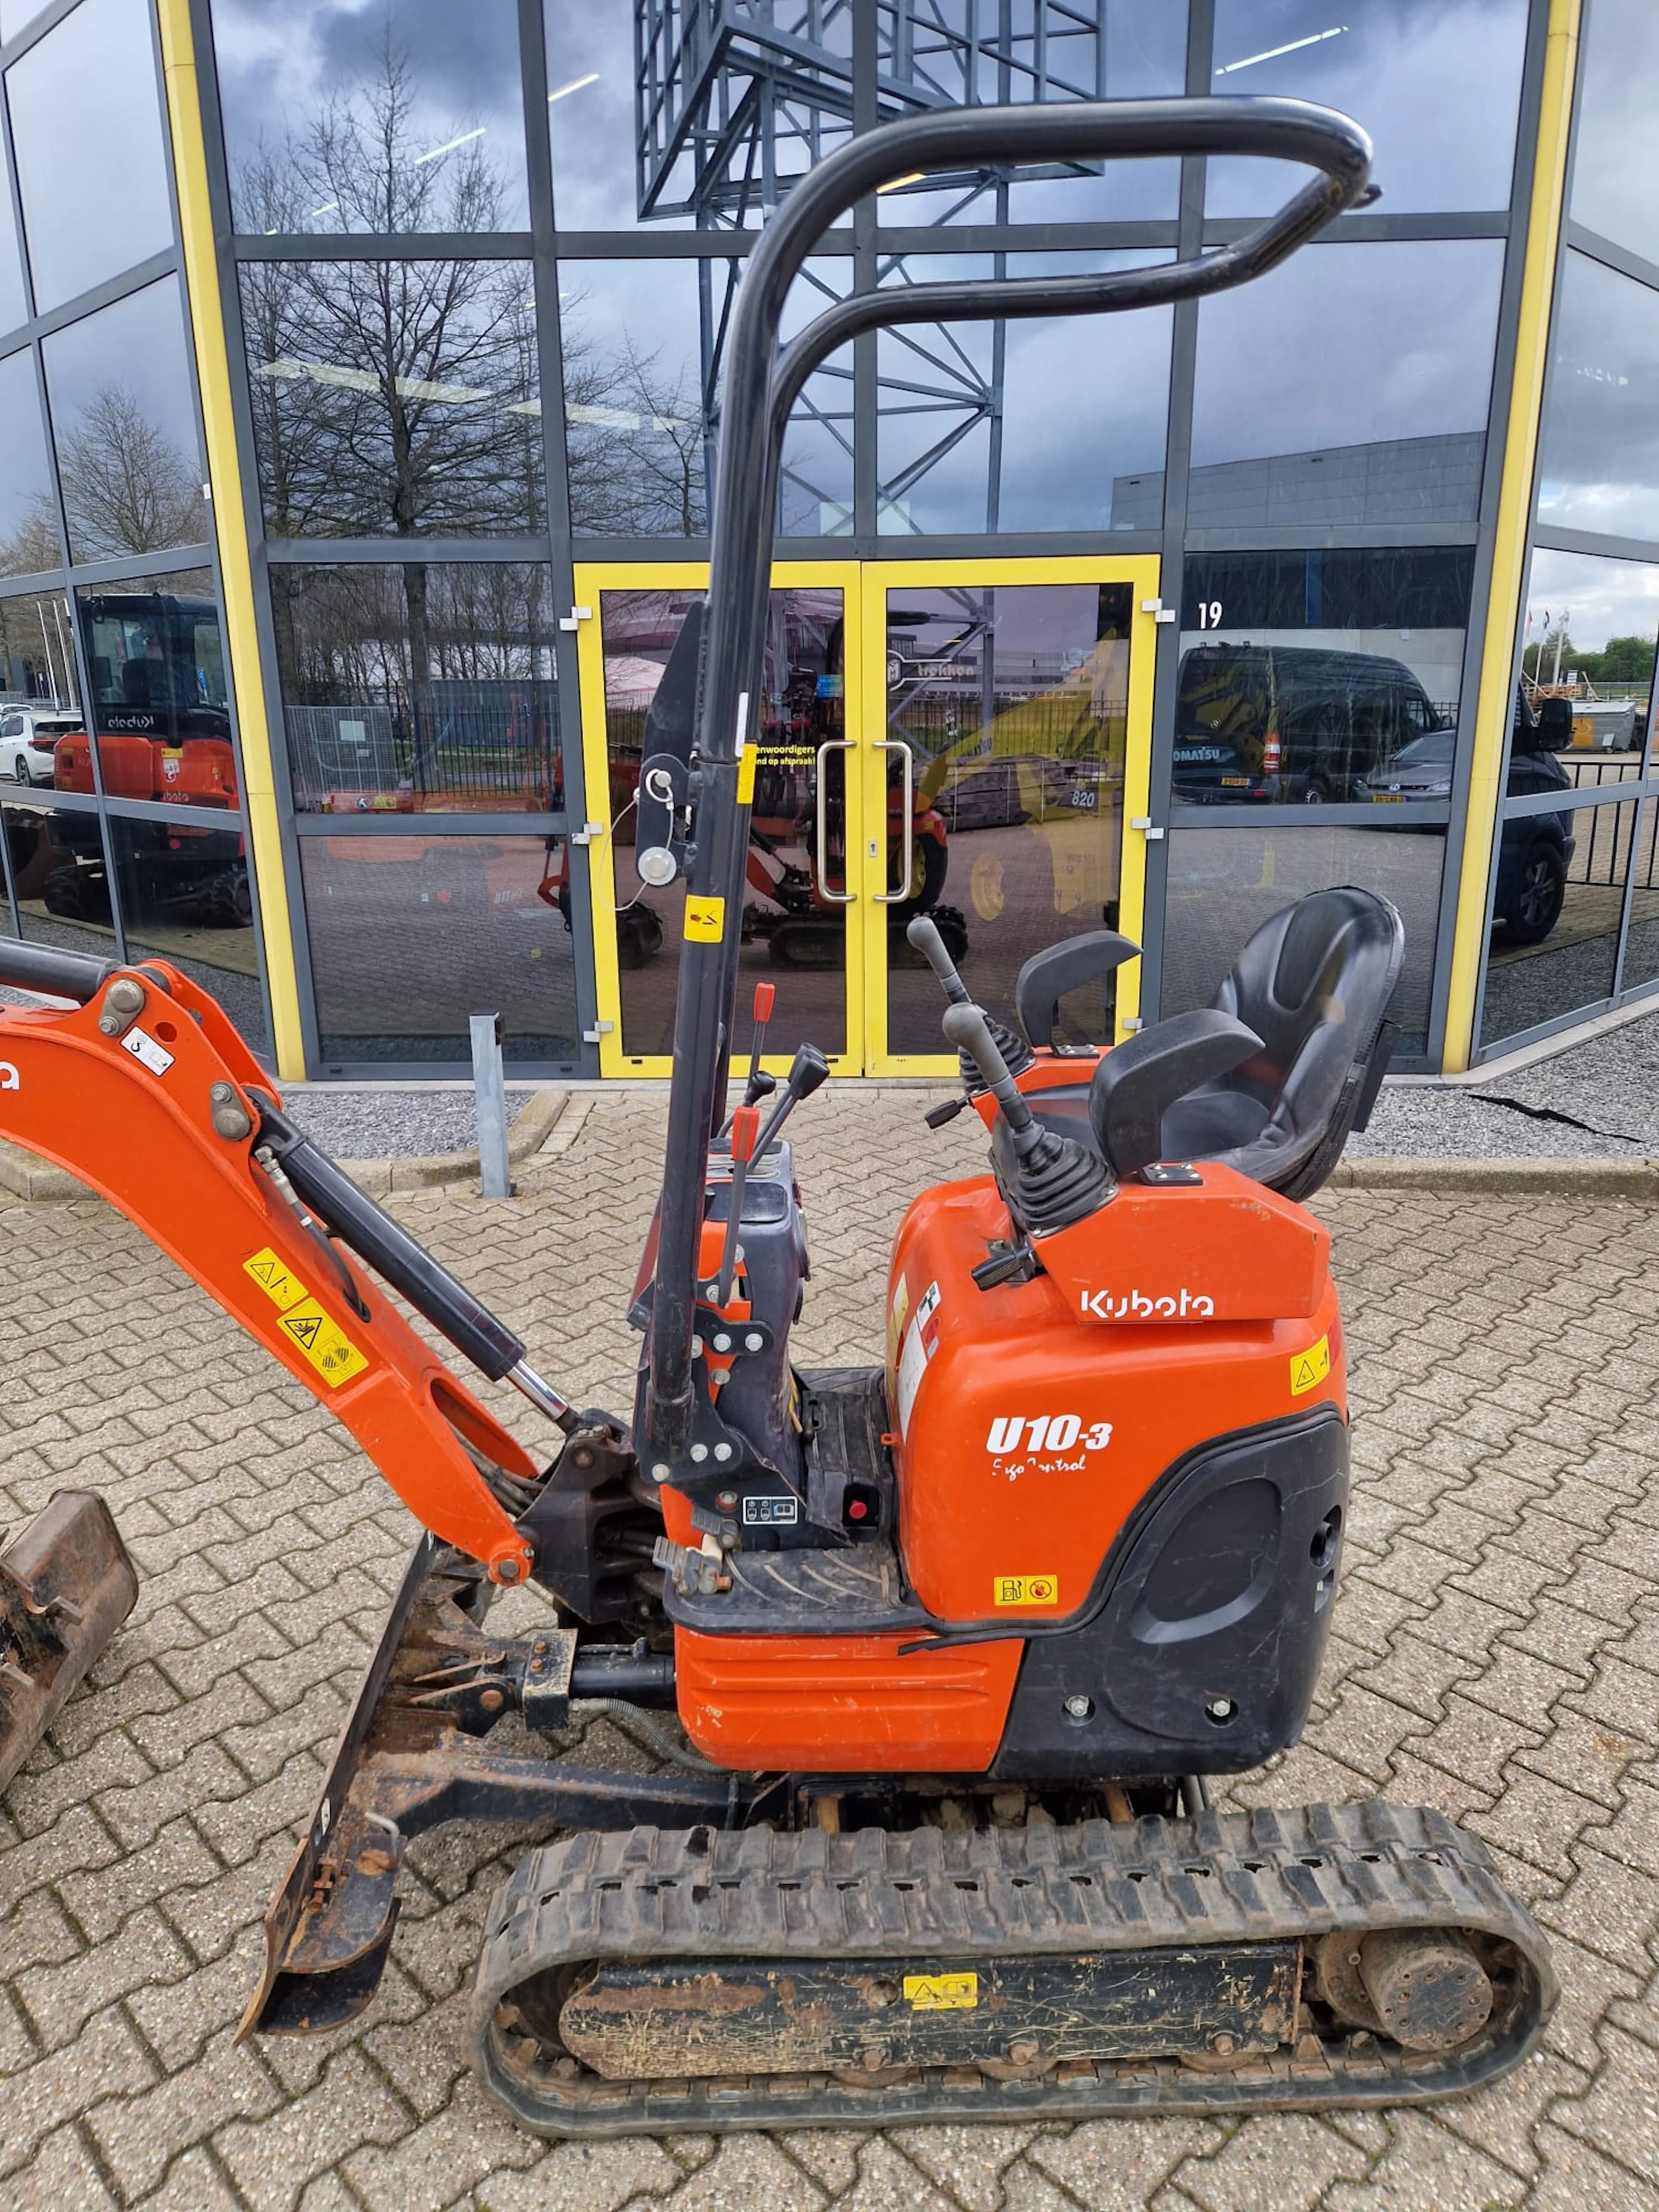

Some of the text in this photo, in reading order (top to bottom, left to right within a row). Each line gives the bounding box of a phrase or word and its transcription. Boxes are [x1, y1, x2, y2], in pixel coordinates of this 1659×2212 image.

[1198, 601, 1222, 629] 19
[1072, 790, 1095, 807] 820
[1081, 1288, 1214, 1318] Kubota
[986, 1414, 1113, 1454] U10-3
